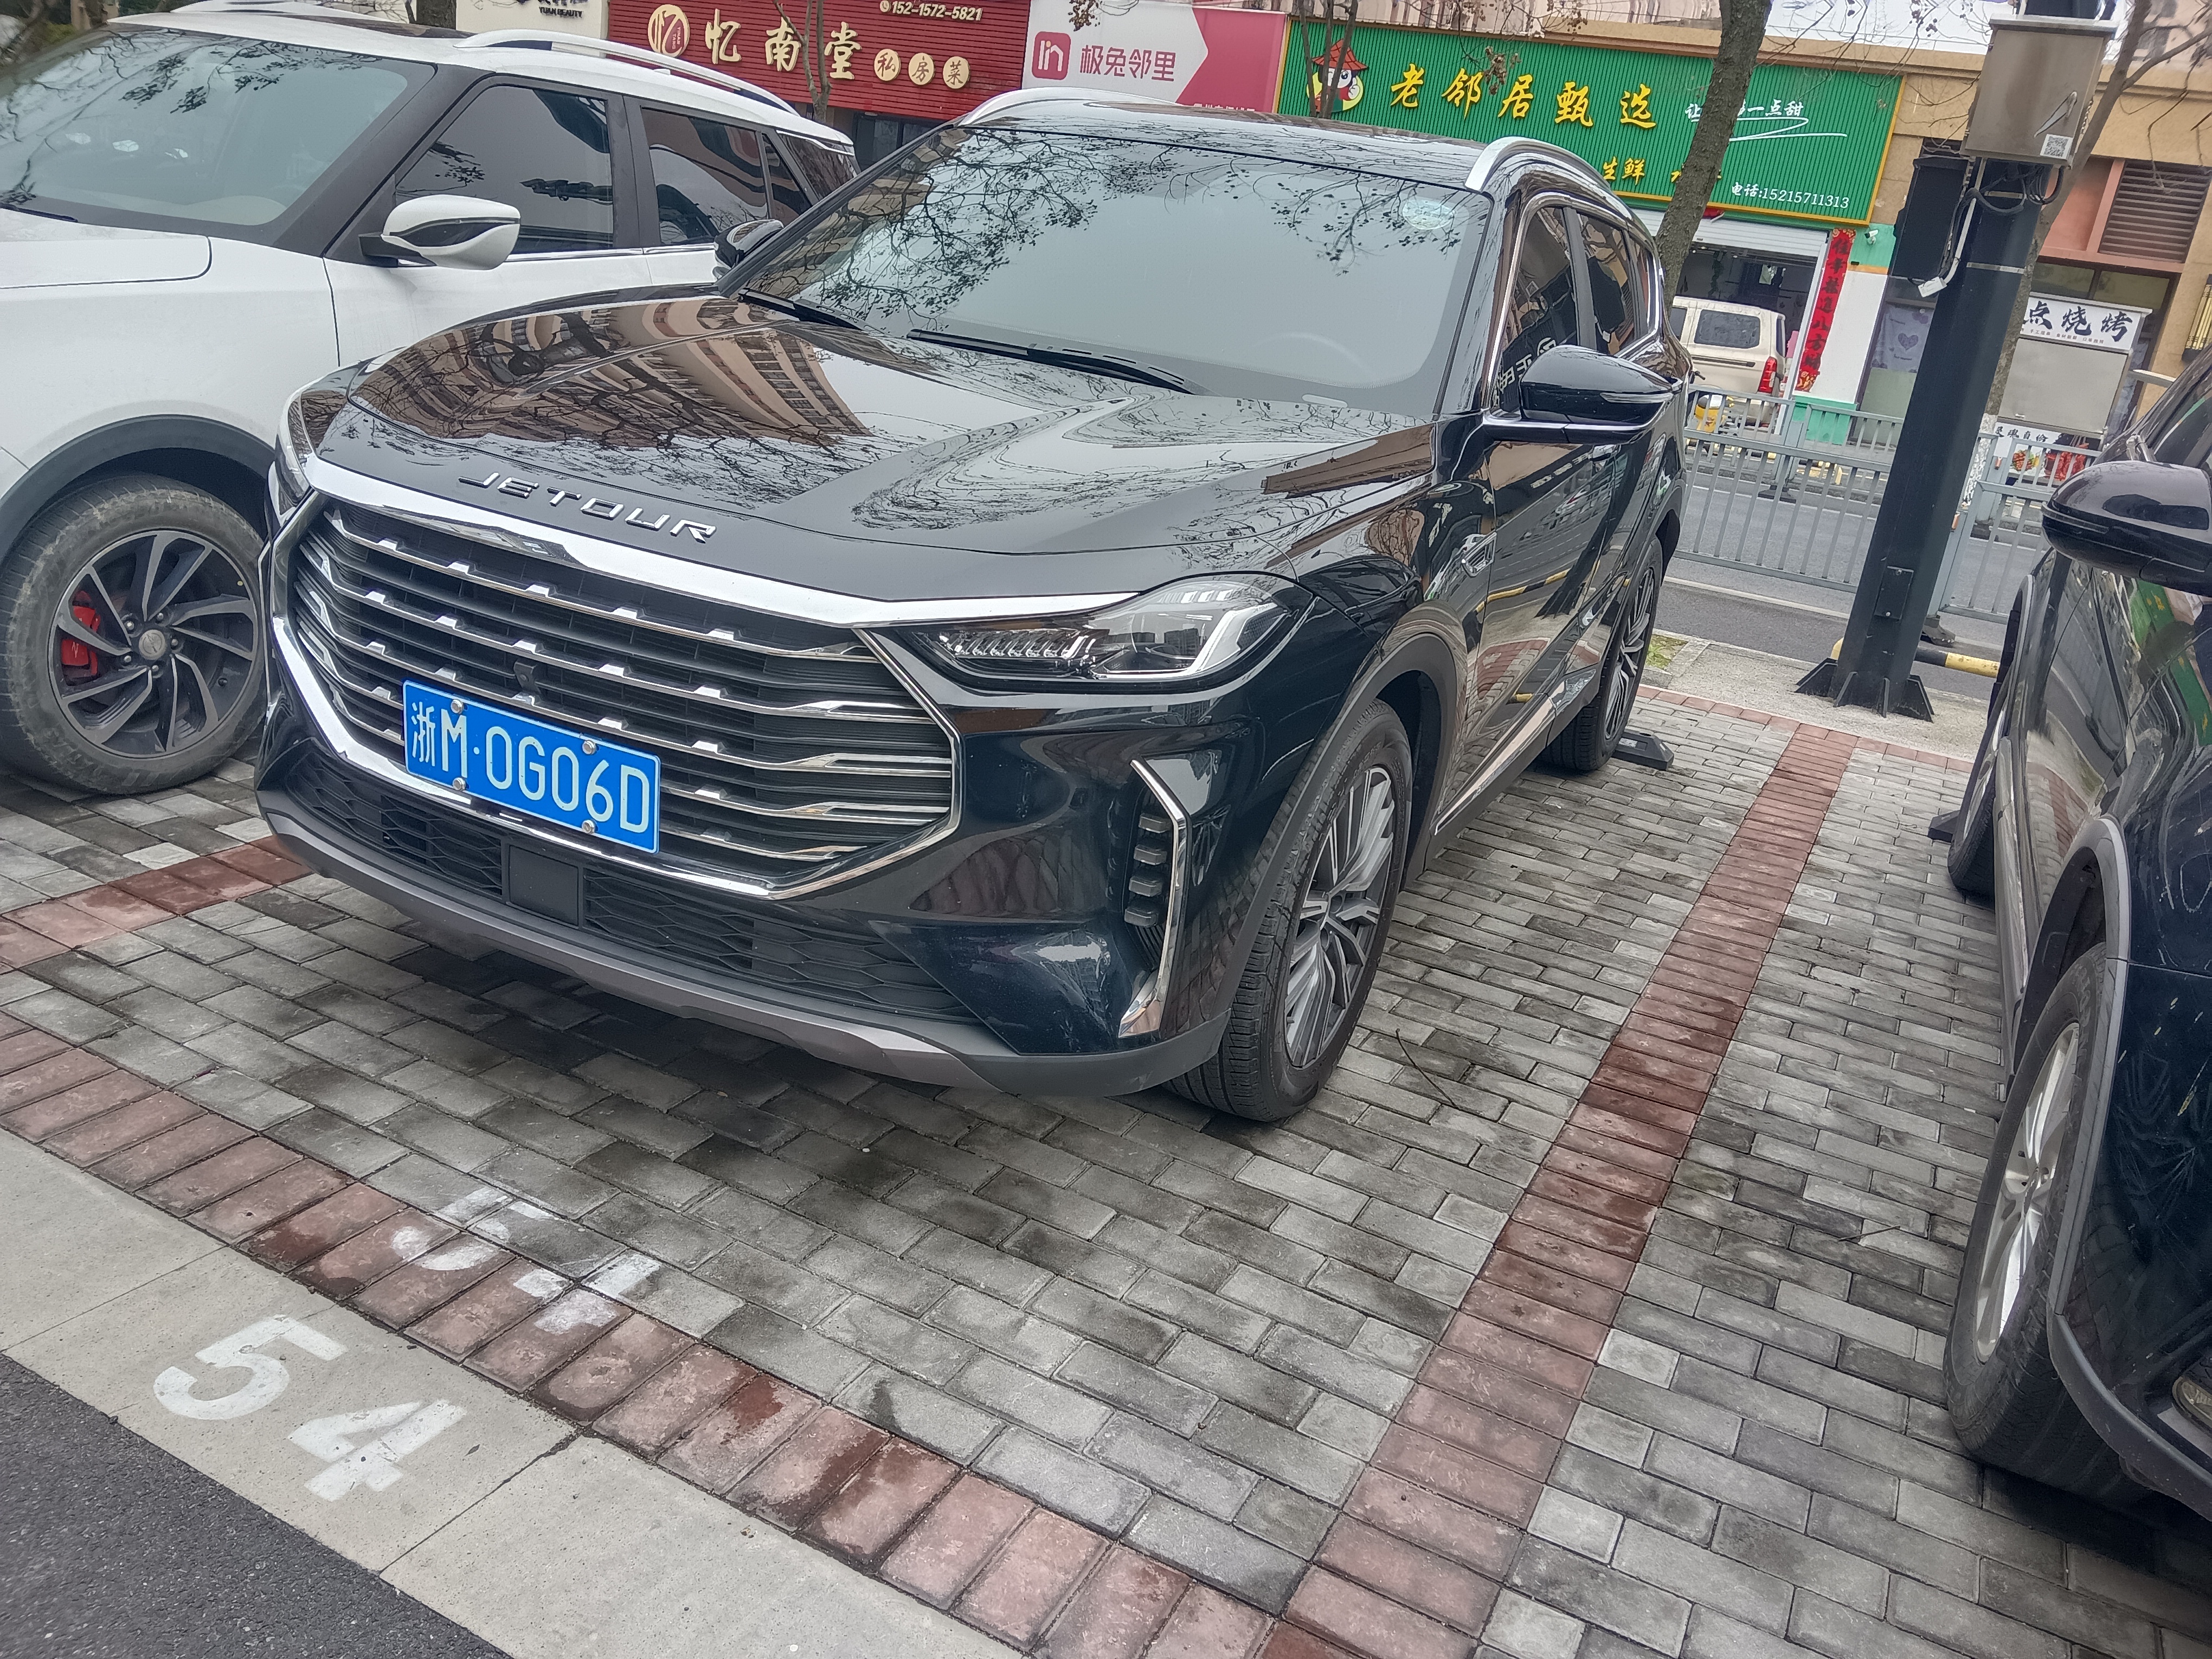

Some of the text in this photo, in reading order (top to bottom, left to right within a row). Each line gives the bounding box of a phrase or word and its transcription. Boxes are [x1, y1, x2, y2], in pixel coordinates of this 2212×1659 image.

[557, 9, 582, 18] BEAUTY
[892, 2, 983, 21] 152-1572-5821
[705, 9, 861, 80] 忆南堂
[1080, 45, 1176, 81] 极兔邻里
[877, 53, 963, 85] 私房菜
[1391, 63, 1657, 130] 老邻居甄选
[1603, 156, 1645, 185] 生鲜
[2023, 301, 2133, 342] 点烧烤
[459, 472, 717, 543] JETOUR
[153, 1314, 467, 1501] 54
